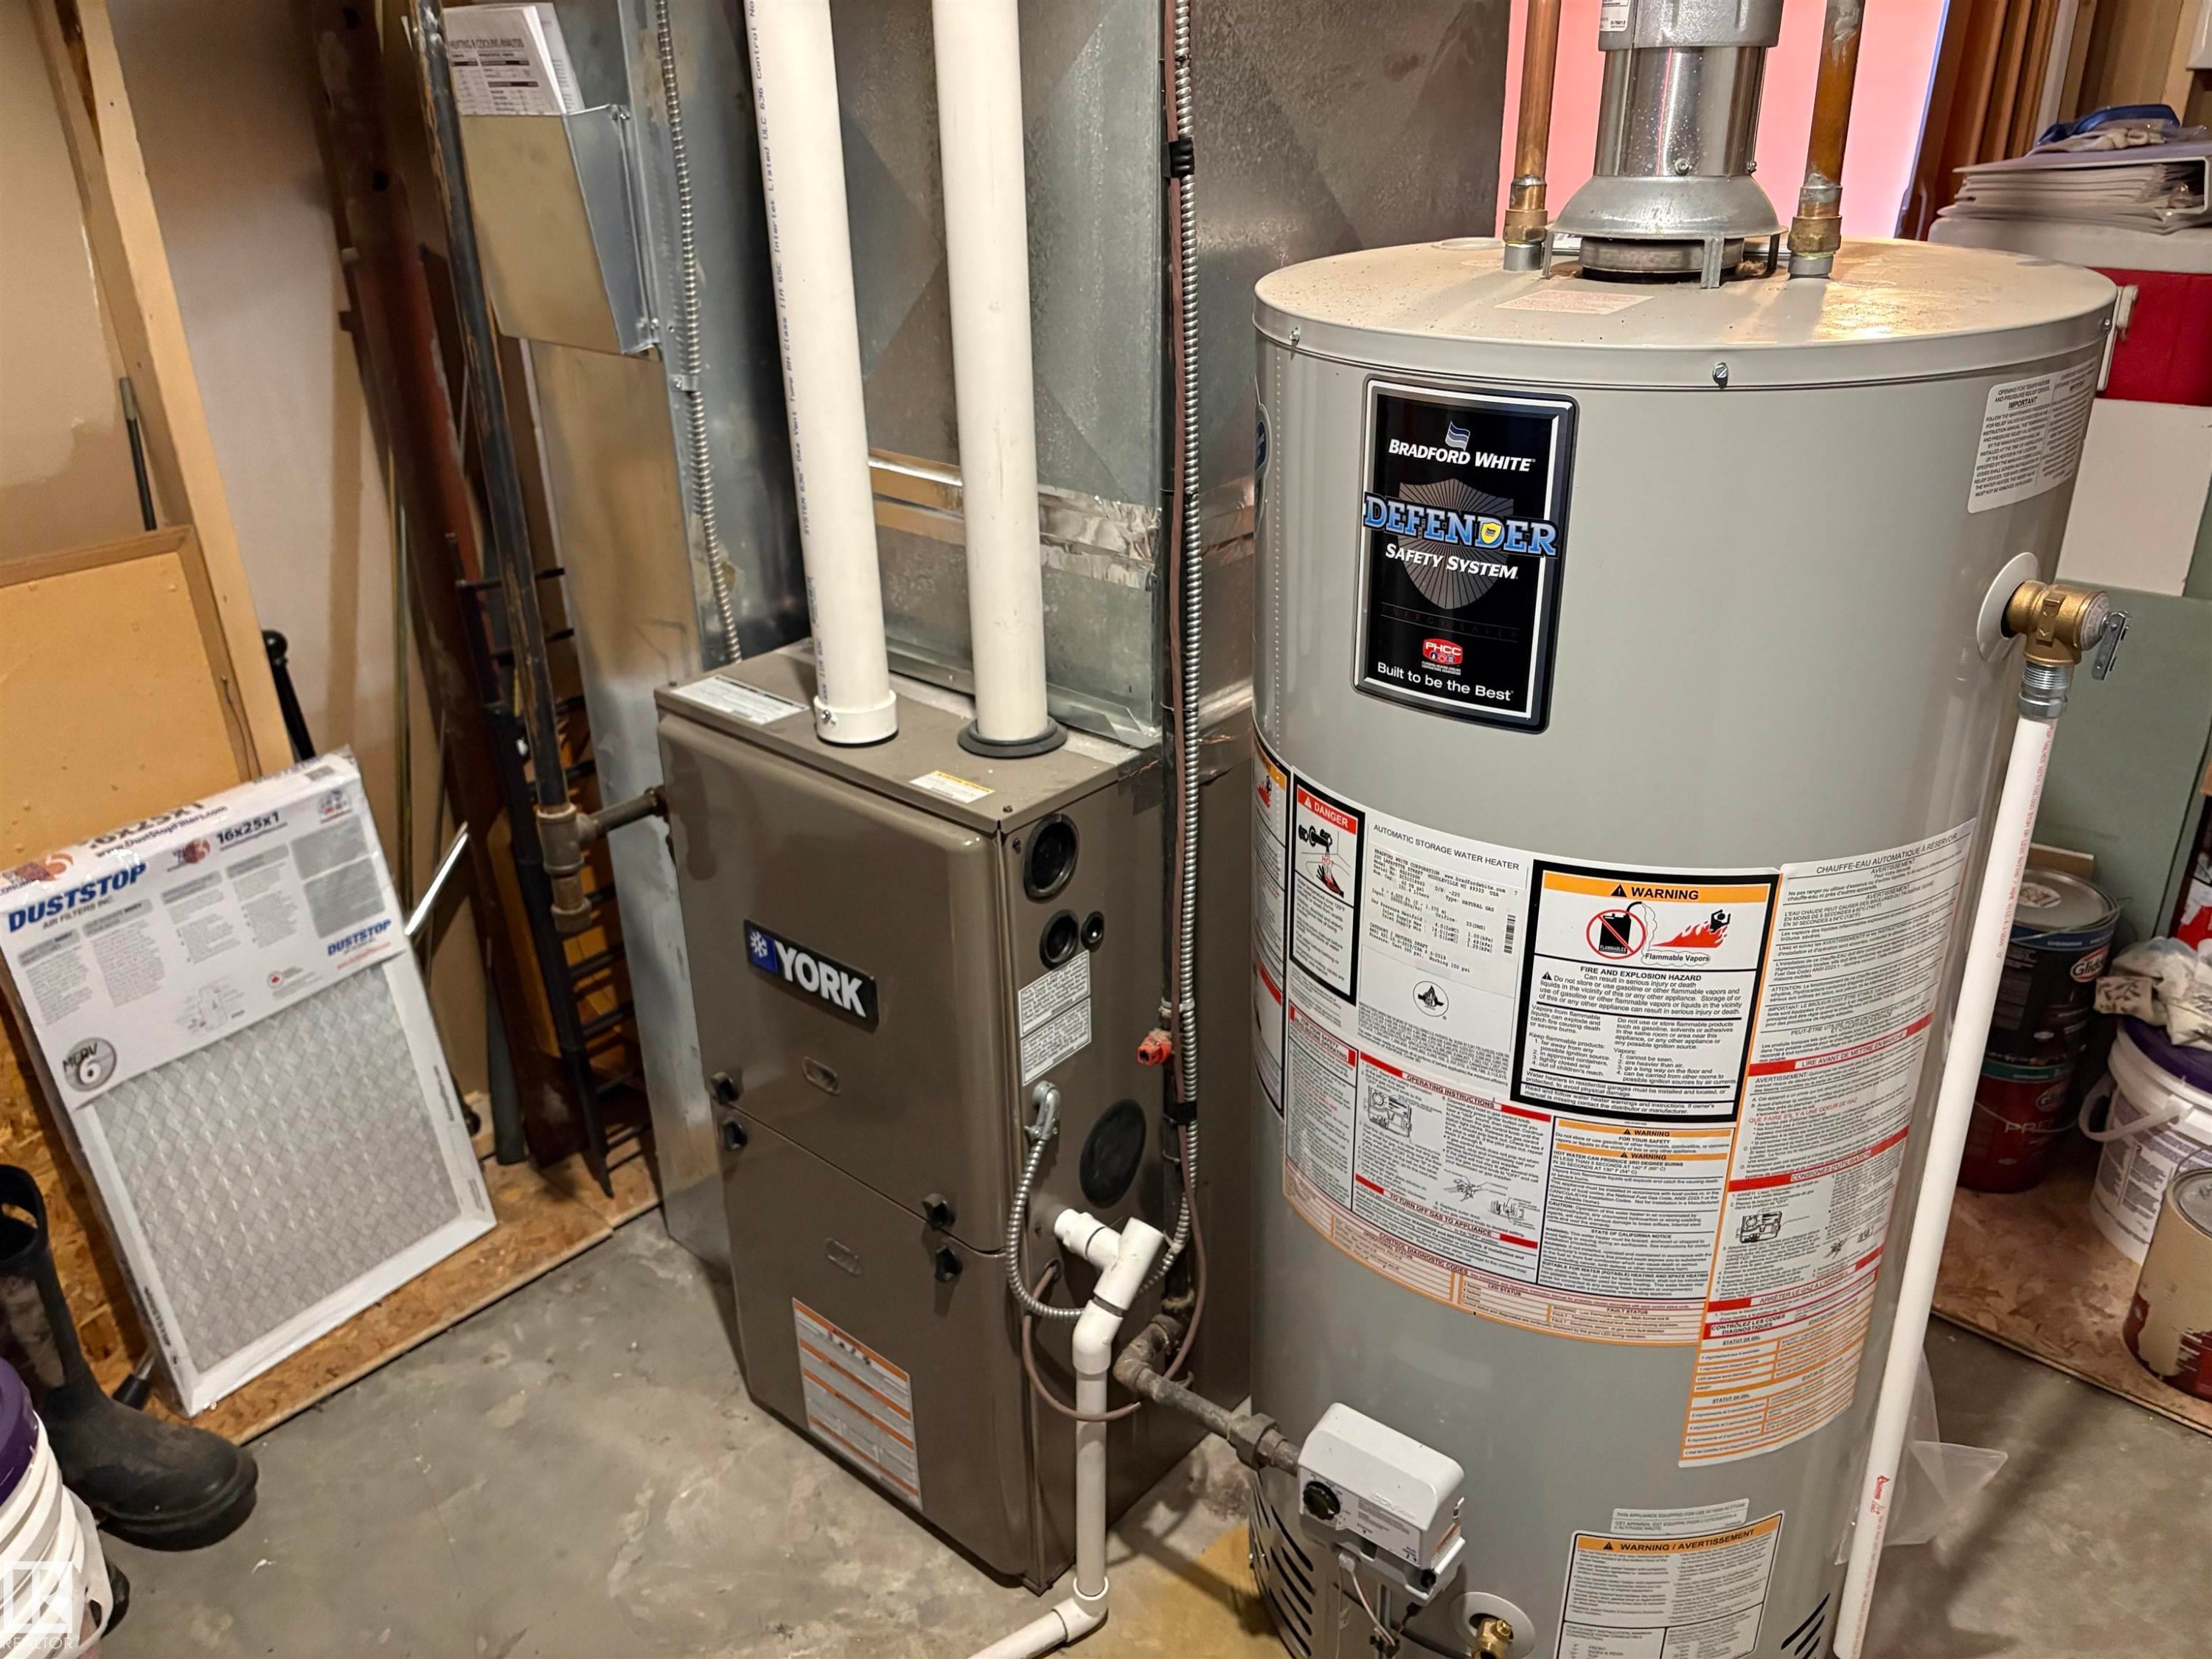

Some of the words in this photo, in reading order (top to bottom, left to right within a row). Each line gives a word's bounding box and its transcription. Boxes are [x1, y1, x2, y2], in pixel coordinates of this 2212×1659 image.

[1388, 439, 1471, 465] BRADFORD
[1474, 451, 1532, 472] WHITE
[1364, 494, 1557, 556] DEFENDER
[1385, 543, 1444, 568] SAFETY
[1446, 555, 1519, 580] SYSTEM
[1424, 641, 1463, 656] PHCC
[1377, 661, 1405, 680] Built
[1408, 669, 1422, 684] to
[1425, 674, 1443, 689] be
[1446, 680, 1471, 694] the
[1475, 684, 1512, 701] Best
[1314, 801, 1349, 829] DANGER
[216, 810, 280, 844] 16x25x1
[1373, 824, 1414, 845] AUTOMATIC
[1415, 838, 1453, 856] STORAGE
[1454, 849, 1484, 863] WATER
[1484, 855, 1520, 871] HEATER
[1816, 860, 1871, 874] CHAUFFE-EAU
[1871, 846, 1920, 866] AUTOMATIQUE
[1871, 858, 1916, 874] AVERTISSEMENT
[7, 861, 147, 934] DUSTSTOP
[1631, 886, 1700, 900] WARNING
[1865, 884, 1911, 900] AVERTISSEMENT
[43, 917, 58, 930] AIR
[59, 902, 97, 924] FILTERS
[327, 919, 392, 957] DUSTSTOP
[1644, 953, 1684, 962] Flammable
[1685, 954, 1711, 964] Vapors
[774, 939, 866, 1018] YORK
[1580, 966, 1599, 974] FIRE
[1600, 968, 1618, 976] AND
[1619, 970, 1667, 981] EXPLOSION
[1599, 975, 1617, 984] result
[1626, 978, 1649, 987] serious
[1540, 980, 1561, 989] liquids
[1581, 986, 1603, 996] vicinity
[1700, 995, 1725, 1003] Storage
[1576, 979, 1593, 987] store
[1615, 984, 1644, 992] gasoline
[1559, 990, 1587, 1000] gasoline
[1615, 997, 1649, 1006] flammable
[1649, 1001, 1672, 1009] vapors
[1680, 1001, 1701, 1009] liquids
[1818, 1054, 1840, 1065] AVANT
[1406, 1074, 1444, 1093] OPERATING
[1445, 1089, 1495, 1109] INSTRUCTIONS
[1566, 1152, 1586, 1160] WATER
[1600, 1156, 1628, 1164] PRODUCE
[1631, 1152, 1666, 1161] WARNING
[1454, 1220, 1492, 1236] APPLIANCE
[1620, 1543, 1670, 1551] WARNING
[1677, 1528, 1755, 1550] AVERTISSEMENT
